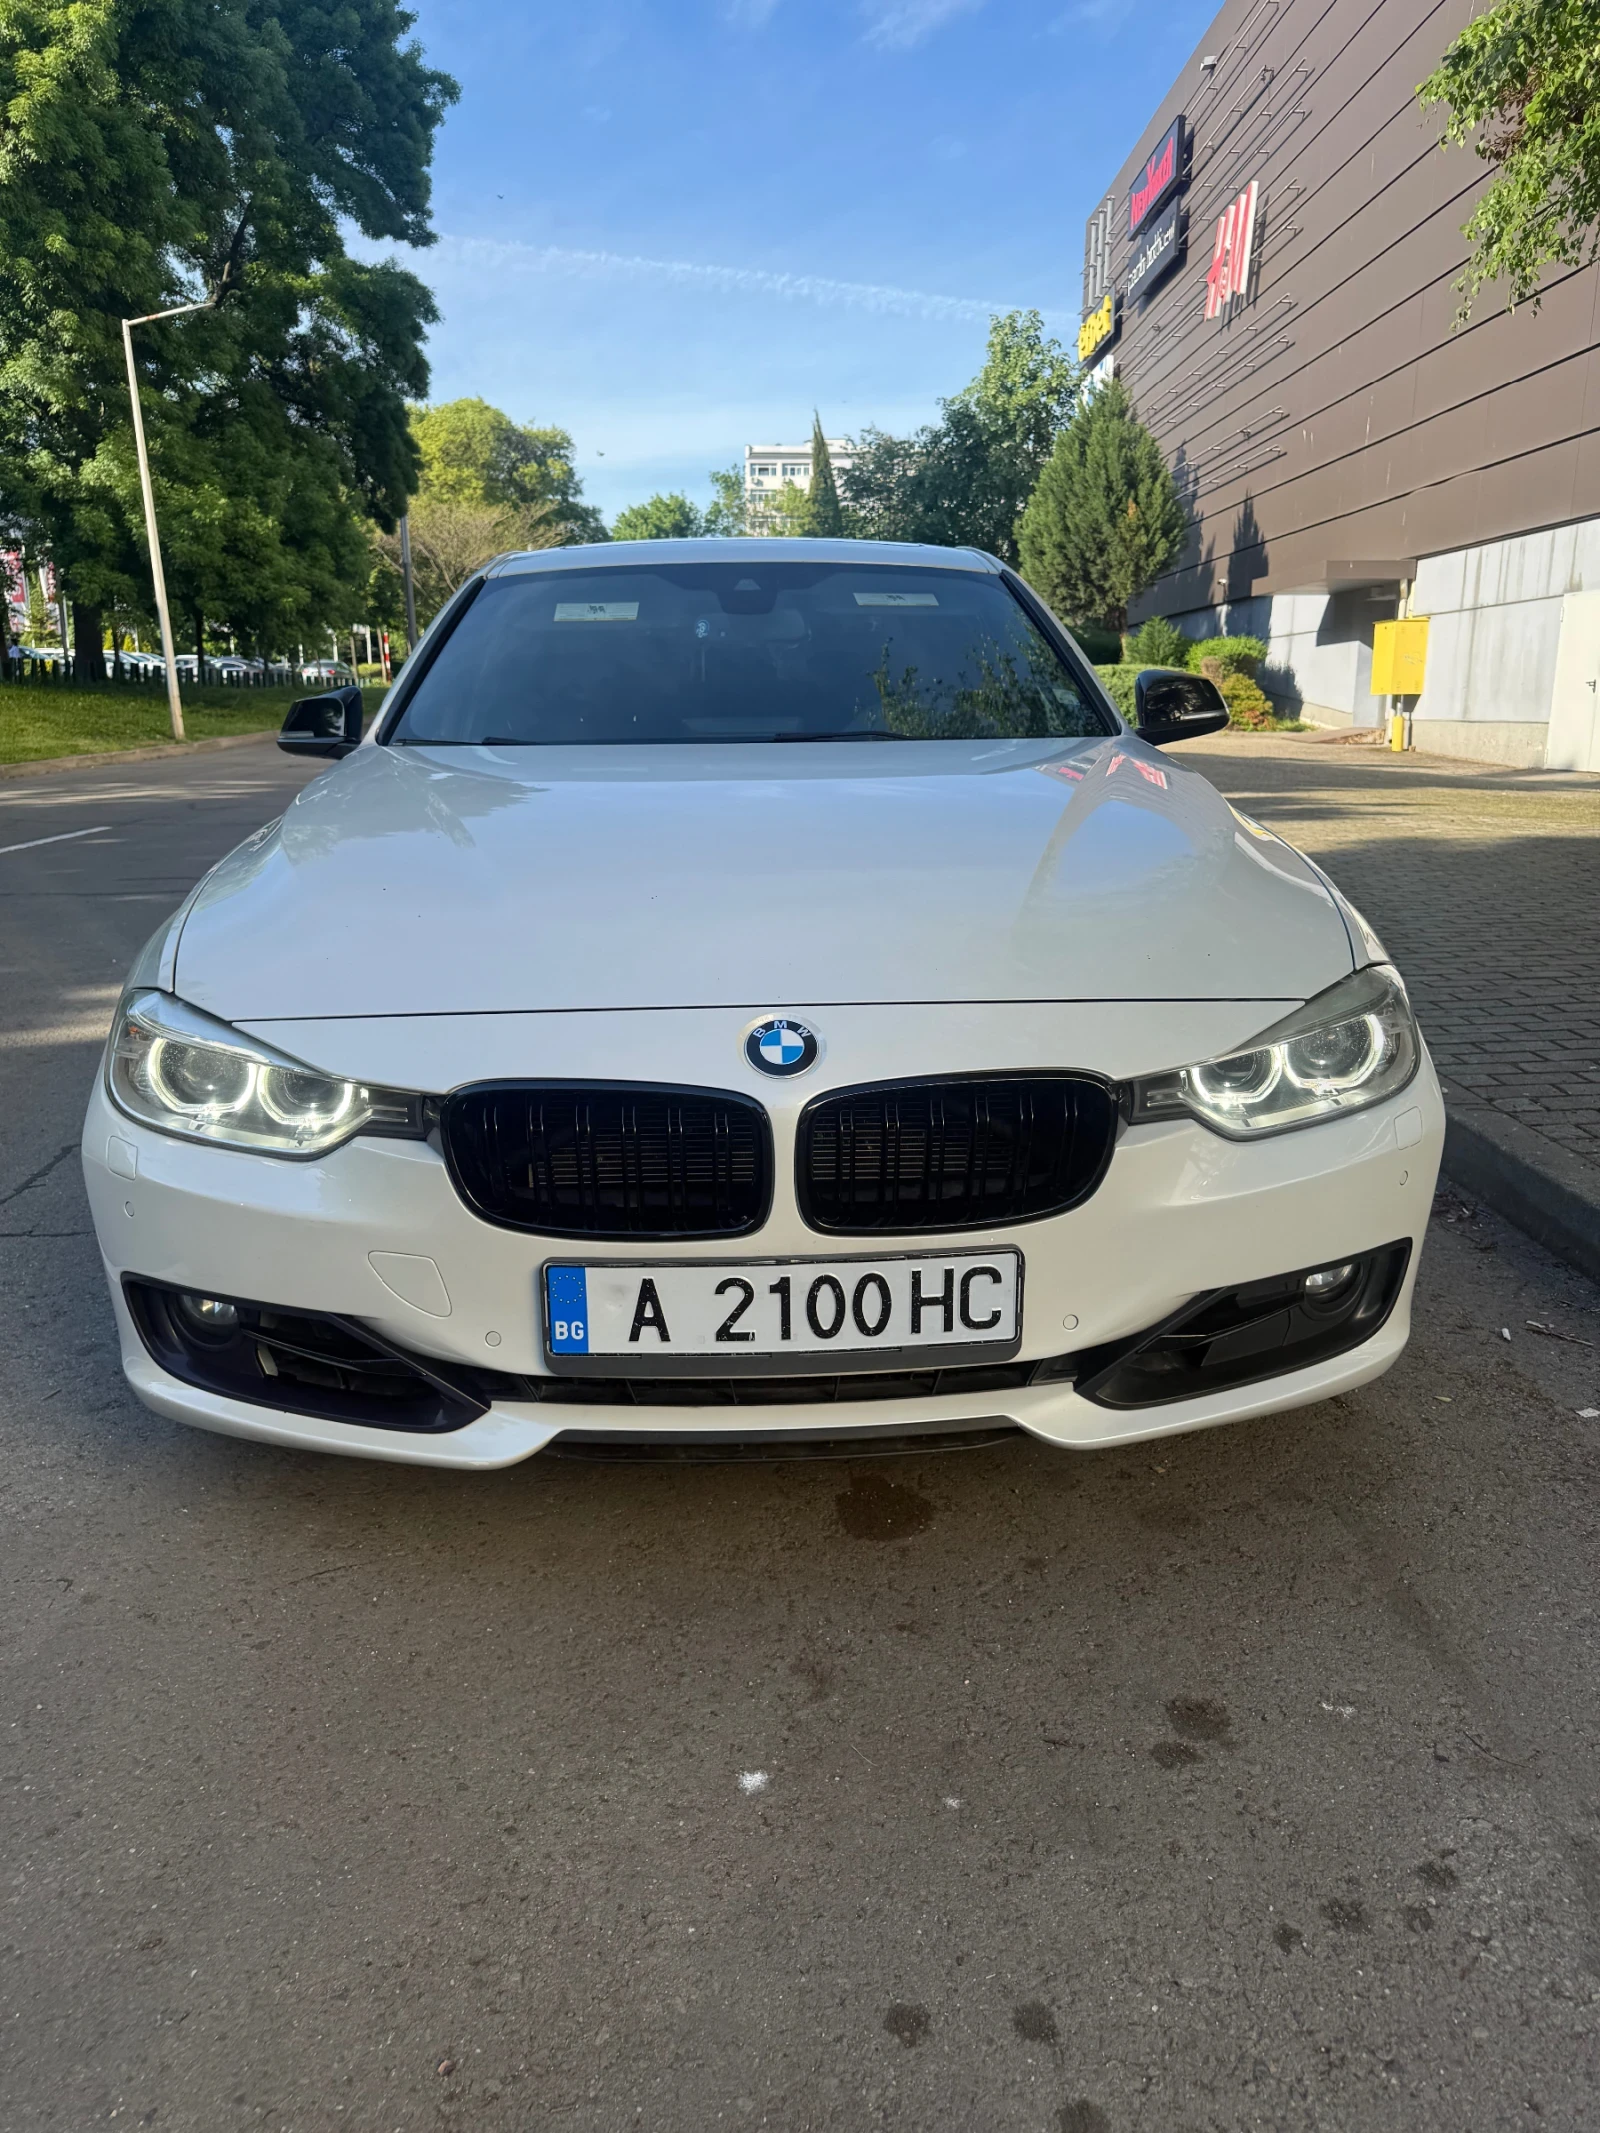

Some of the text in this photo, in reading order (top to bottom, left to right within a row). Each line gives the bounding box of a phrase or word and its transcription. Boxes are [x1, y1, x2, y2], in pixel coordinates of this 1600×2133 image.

[752, 1020, 812, 1038] BMW
[628, 1264, 1003, 1342] A 2100 HC
[554, 1320, 585, 1341] BG
